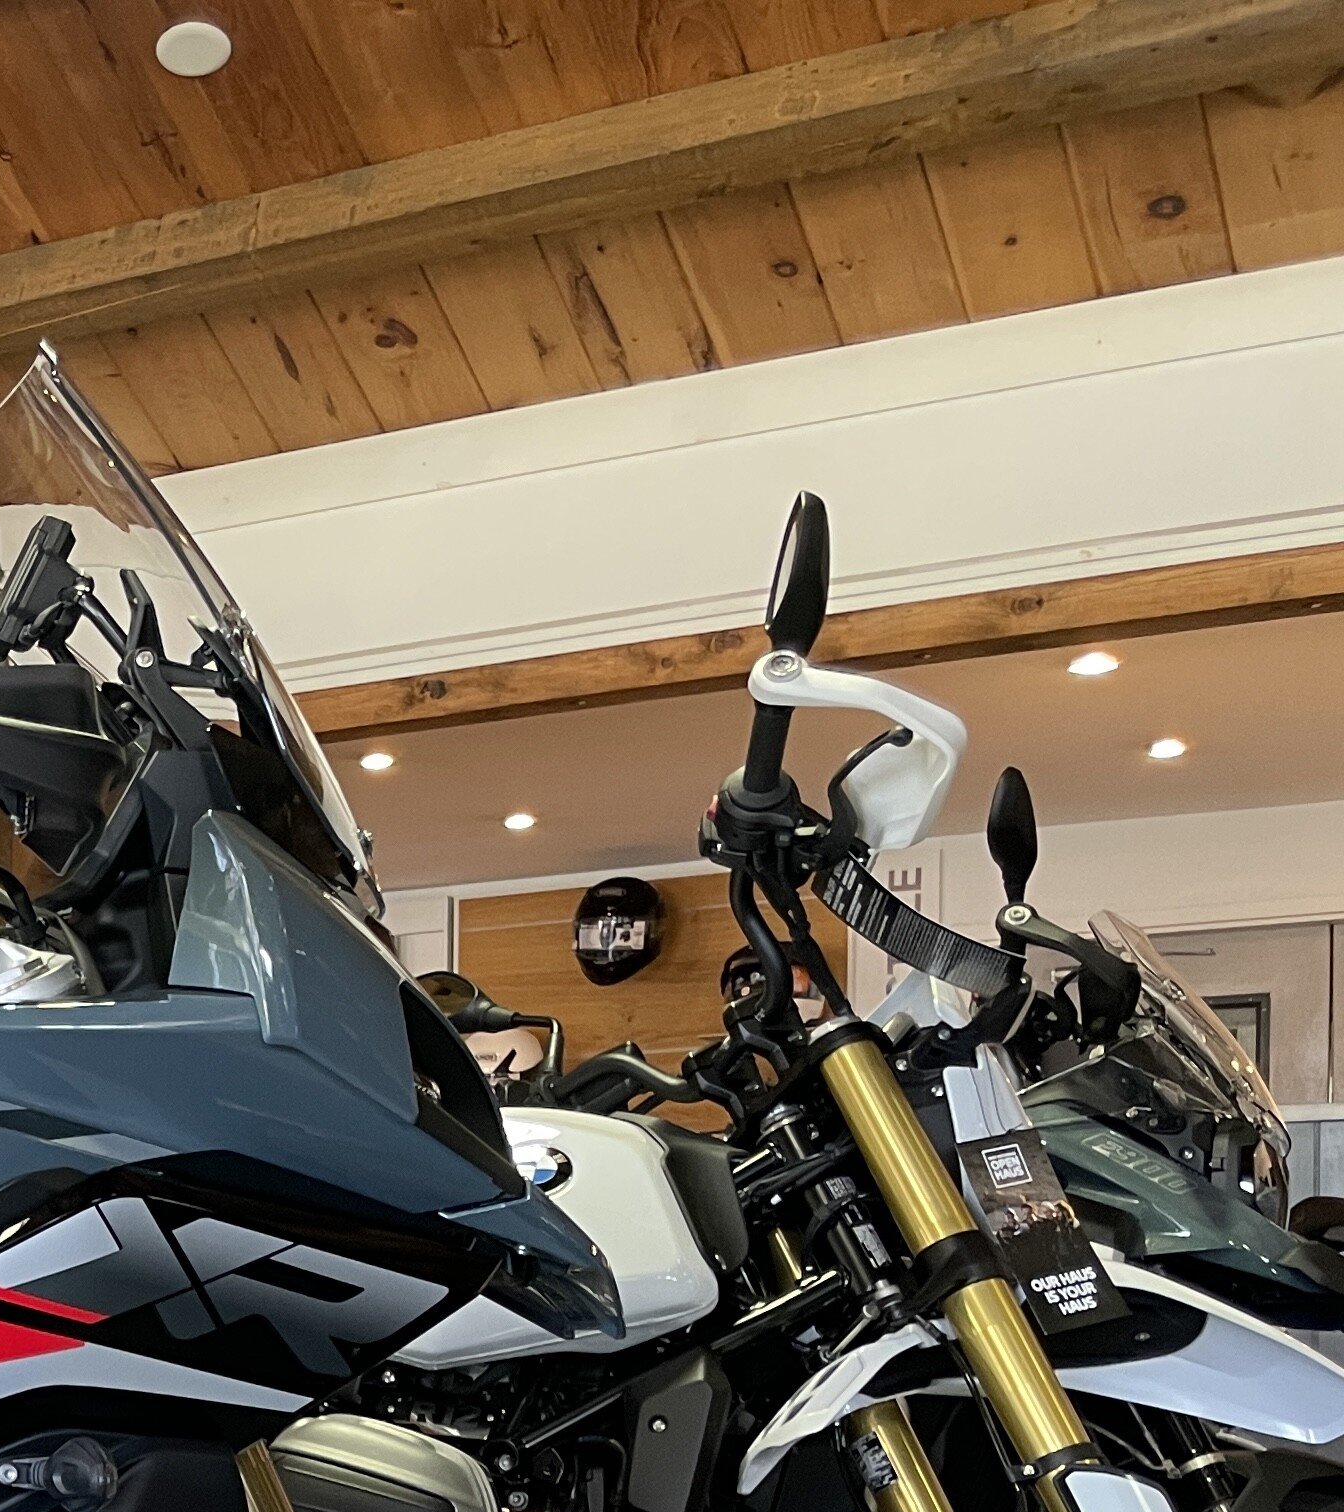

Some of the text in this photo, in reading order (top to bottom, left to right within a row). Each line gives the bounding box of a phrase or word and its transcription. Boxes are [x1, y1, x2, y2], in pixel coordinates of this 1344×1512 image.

[990, 1155, 1021, 1170] OPEN
[994, 1165, 1024, 1181] HAUS
[22, 1197, 449, 1378] XR
[1030, 1266, 1097, 1293] OUR HAUS
[1044, 1280, 1098, 1304] IS YOUR
[1058, 1297, 1098, 1316] HAUS
